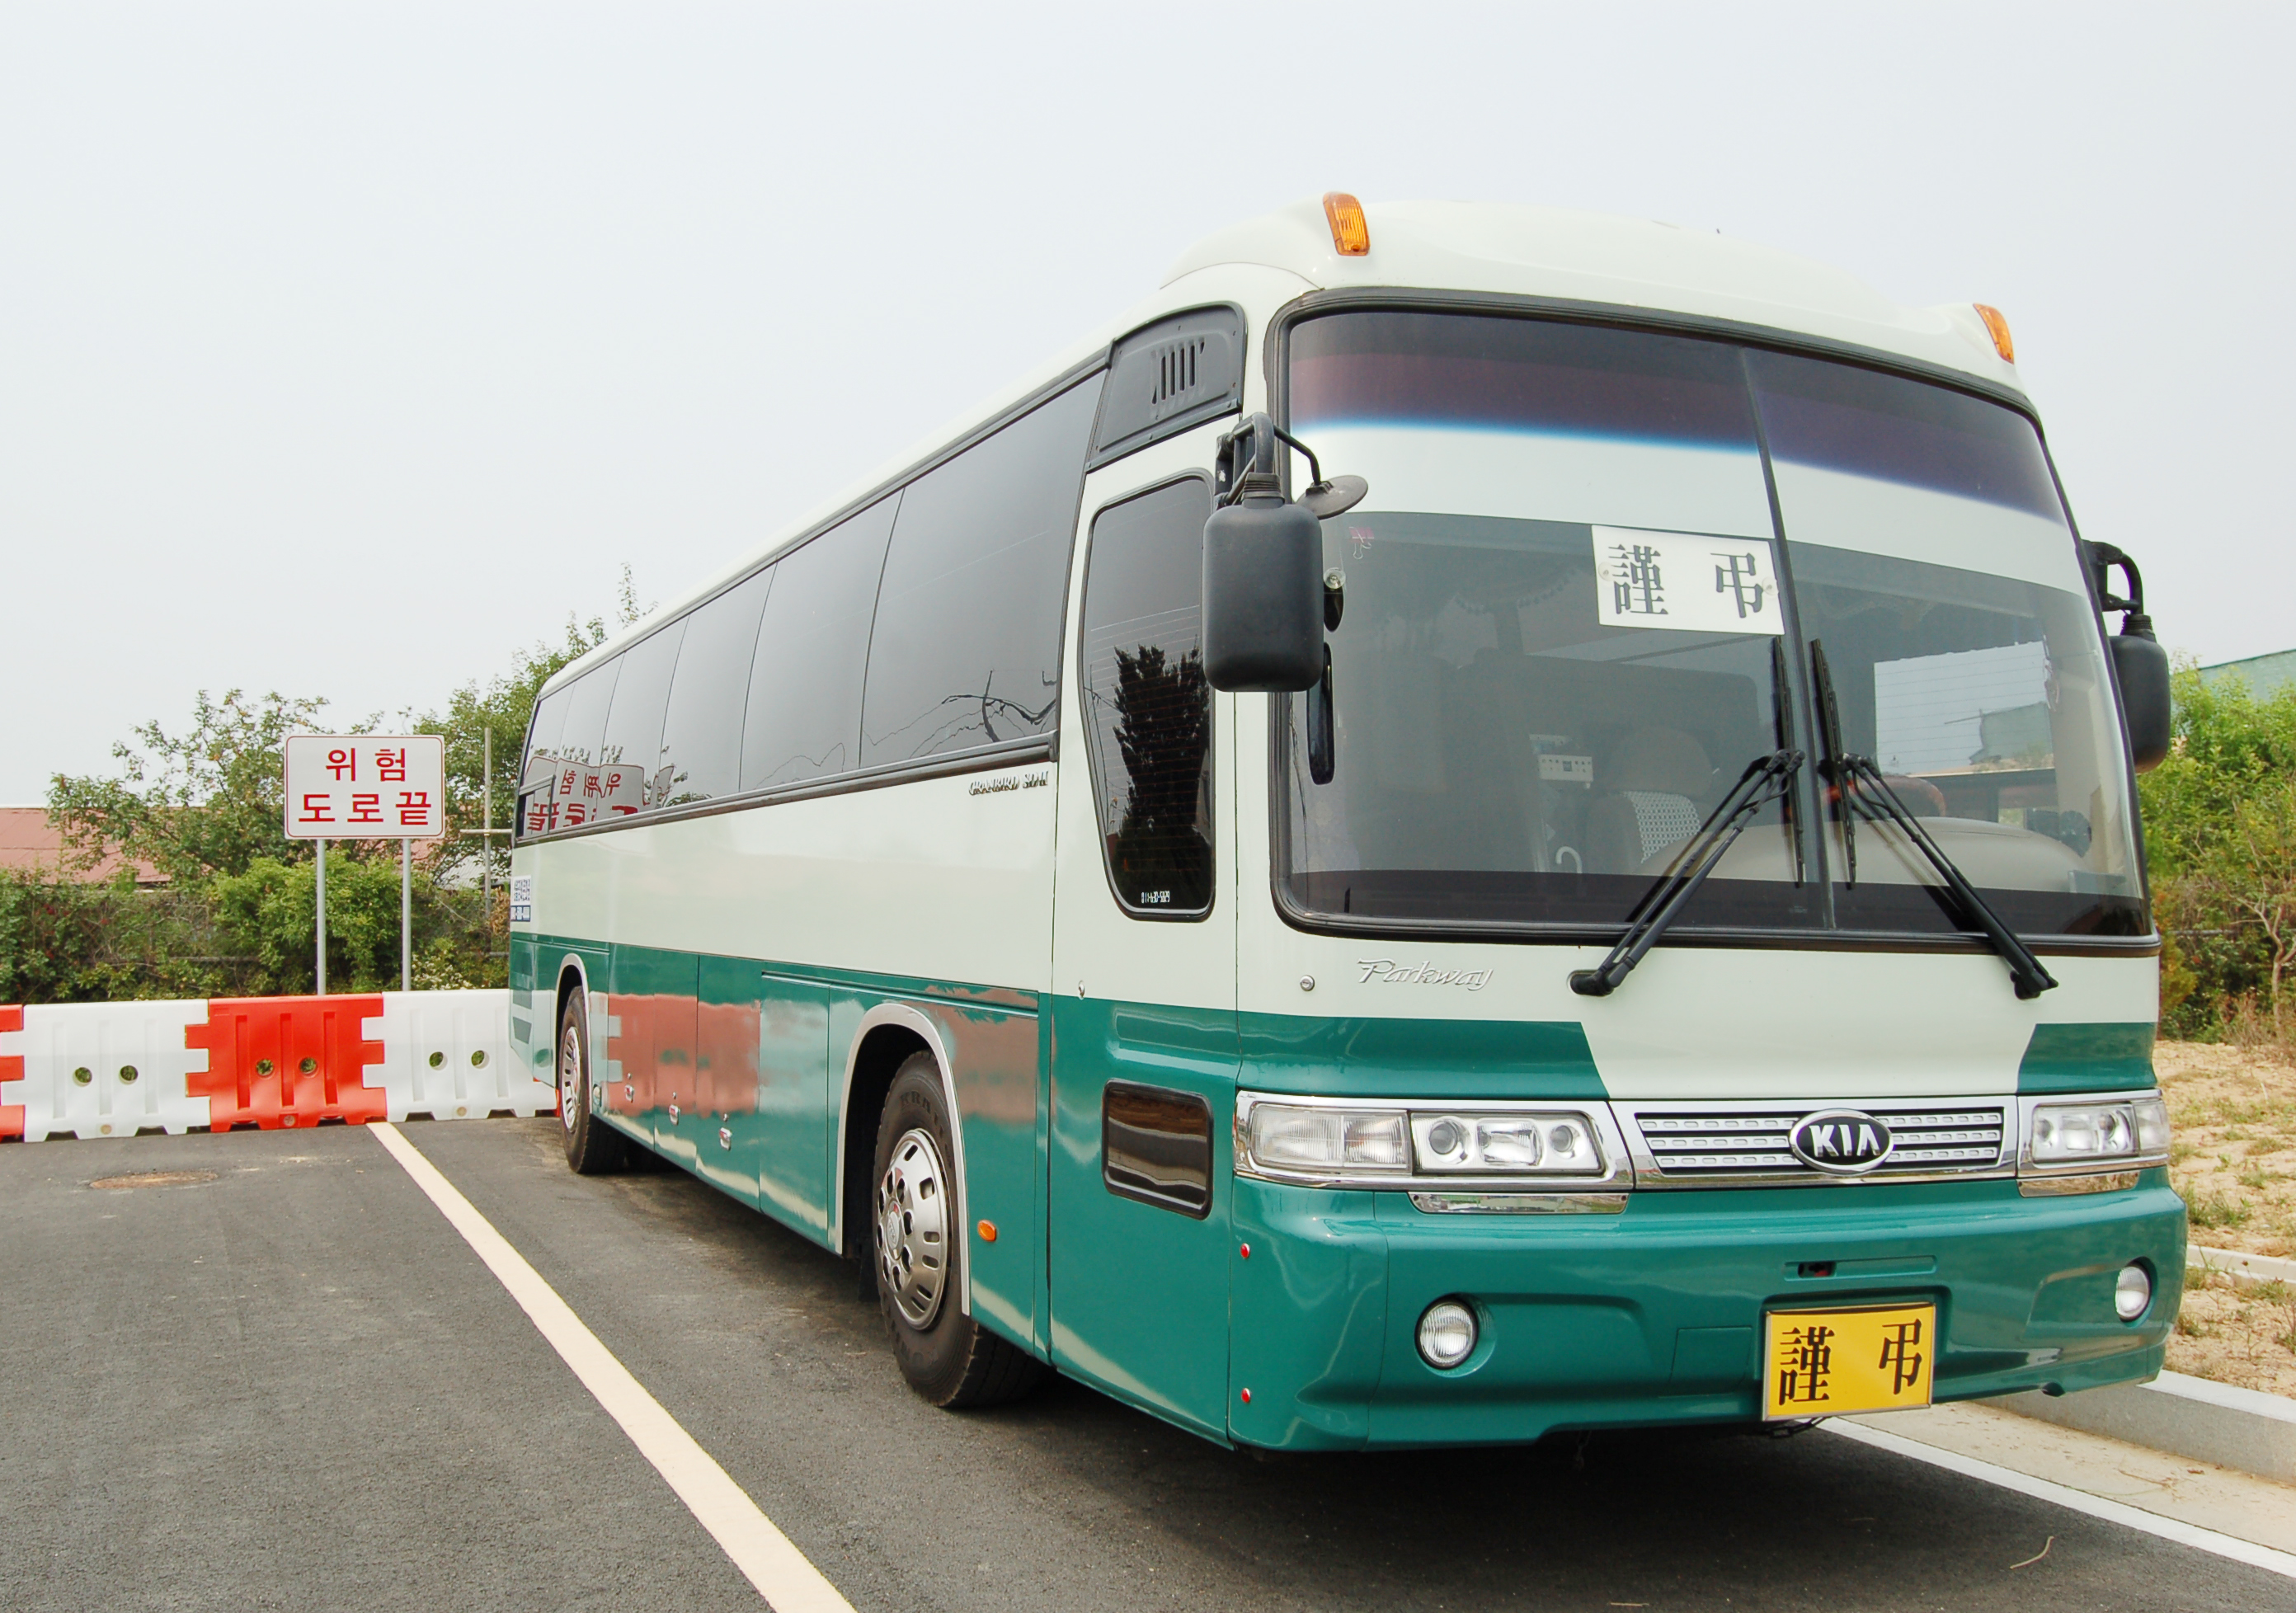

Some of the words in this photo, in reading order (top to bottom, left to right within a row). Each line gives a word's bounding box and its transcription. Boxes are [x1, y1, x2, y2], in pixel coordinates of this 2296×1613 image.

[326, 747, 406, 782] 위험
[1357, 957, 1494, 991] Parkway
[1809, 1124, 1881, 1158] KIA
